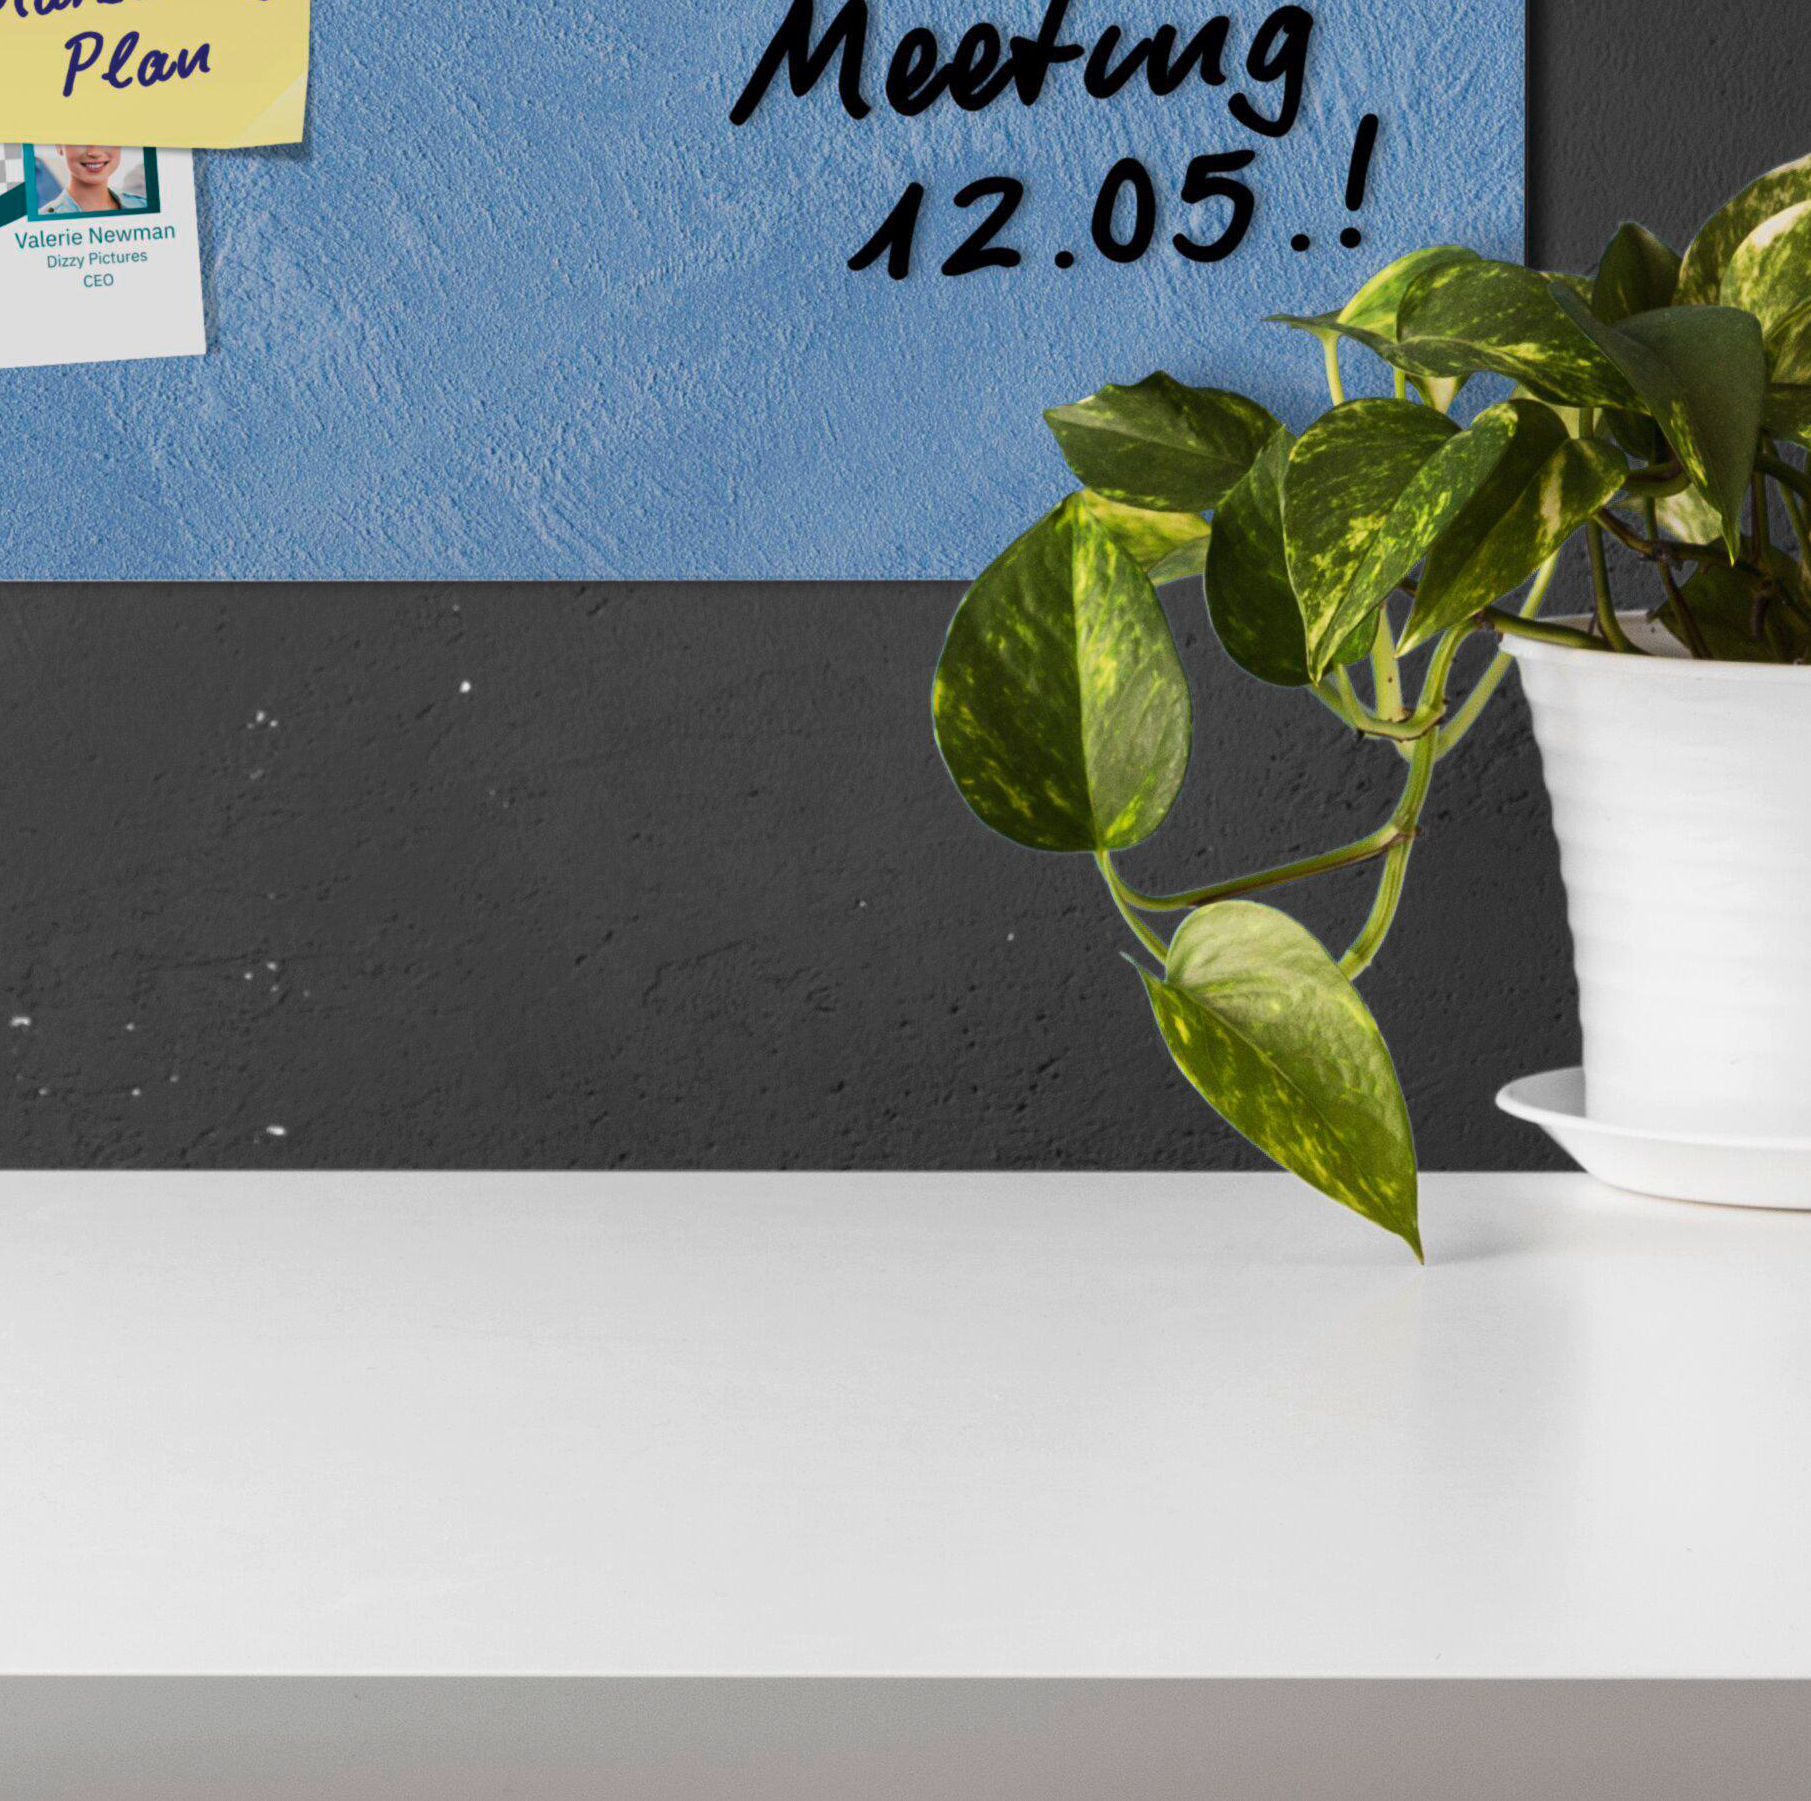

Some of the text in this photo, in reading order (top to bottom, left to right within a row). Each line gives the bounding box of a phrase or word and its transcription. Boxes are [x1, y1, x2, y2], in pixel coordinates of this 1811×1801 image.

[62, 30, 211, 98] Plan
[13, 224, 177, 251] Valerie Newman
[45, 250, 149, 271] Dizzy Pictures
[82, 272, 115, 289] CEO
